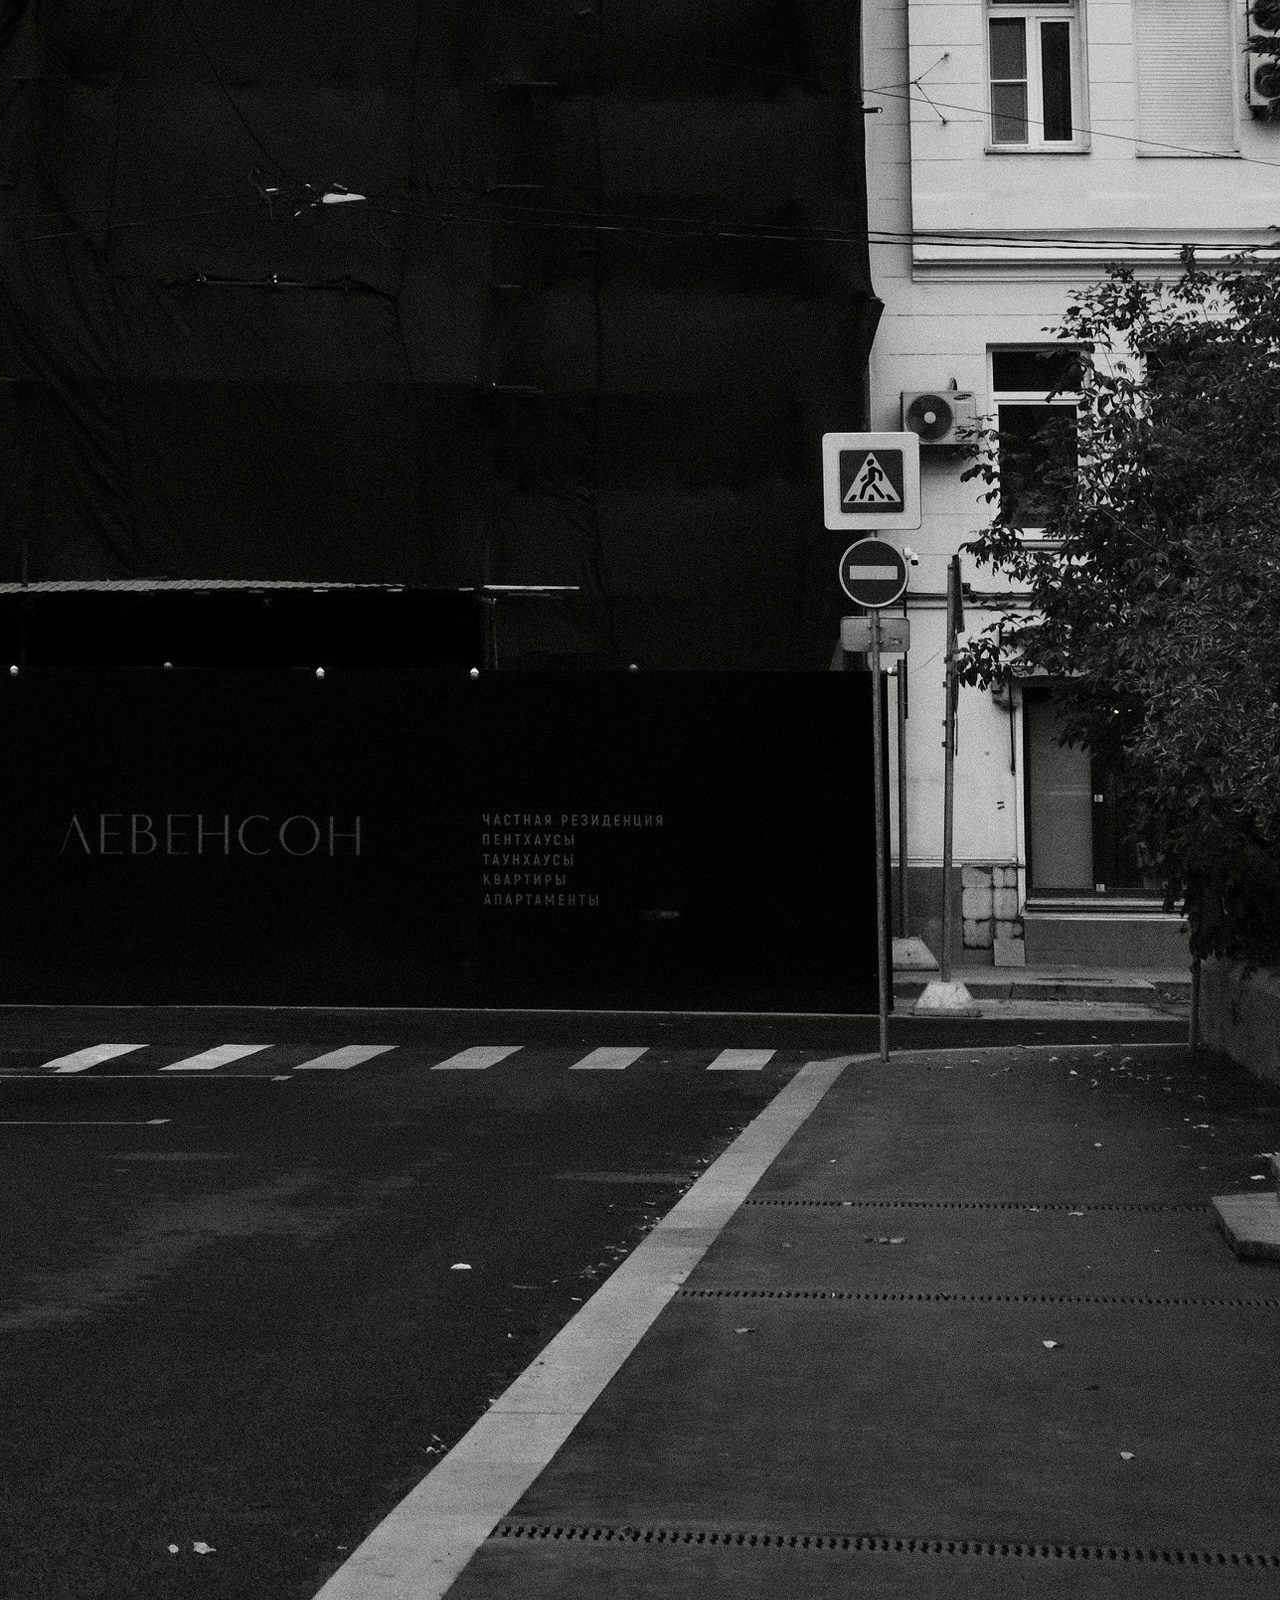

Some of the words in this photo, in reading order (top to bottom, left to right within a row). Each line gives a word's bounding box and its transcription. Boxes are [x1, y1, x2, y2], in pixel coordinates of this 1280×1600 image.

[482, 812, 552, 827] ЧАСТНАЯ
[561, 813, 664, 829] РЕЗИДЕНЦИЯ
[60, 812, 361, 857] ЛЕВЕНСОН
[482, 833, 575, 847] ПЕНТХАУСЫ
[482, 853, 575, 867] ТАУНХАУСЫ
[482, 873, 567, 887] КВАРТИРЫ
[483, 893, 600, 907] АПАРТАМЕНТЫ
